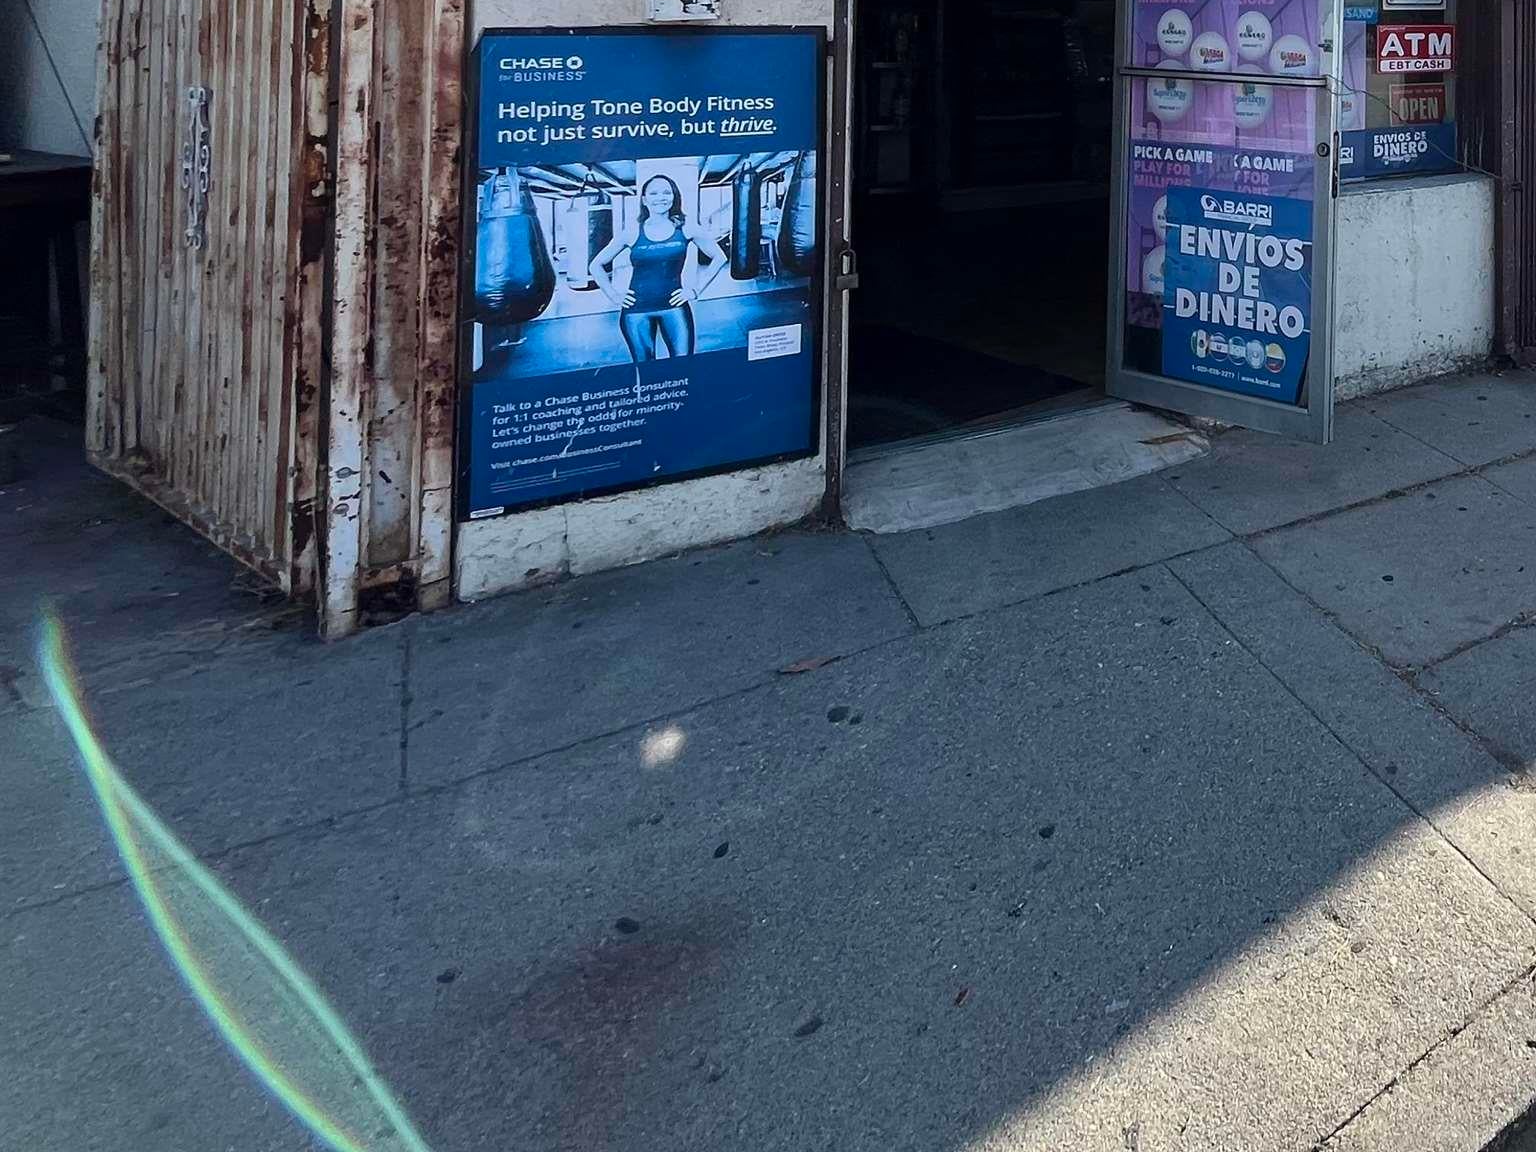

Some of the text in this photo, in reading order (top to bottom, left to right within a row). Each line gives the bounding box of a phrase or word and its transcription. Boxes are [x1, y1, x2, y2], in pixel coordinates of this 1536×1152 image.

[1381, 32, 1452, 57] ATM
[500, 57, 563, 70] CHASE
[1389, 59, 1445, 70] EBT CASH
[498, 96, 774, 121] Helping Tone Body Fitness
[1400, 96, 1439, 121] OPEN
[498, 117, 777, 145] not just survive, but thrive.
[1373, 130, 1427, 145] ENVIOS DE
[1134, 145, 1213, 164] PICK A GAME
[1373, 139, 1428, 159] DINERO
[1134, 160, 1191, 176] PLAY FOR
[1241, 156, 1294, 173] A GAME
[1244, 171, 1269, 186] FOR
[1223, 200, 1272, 219] BARRI
[1180, 223, 1304, 271] ENVÍOS
[1218, 261, 1260, 298] DE
[1175, 287, 1304, 339] DINERO
[492, 388, 689, 426] for 1:1 coaching and tailored advice.
[493, 377, 689, 414] Talk to a Chase Business Consultant
[522, 418, 563, 434] change
[567, 414, 585, 426] the
[618, 407, 634, 419] for
[491, 417, 648, 450] owned businesses together.
